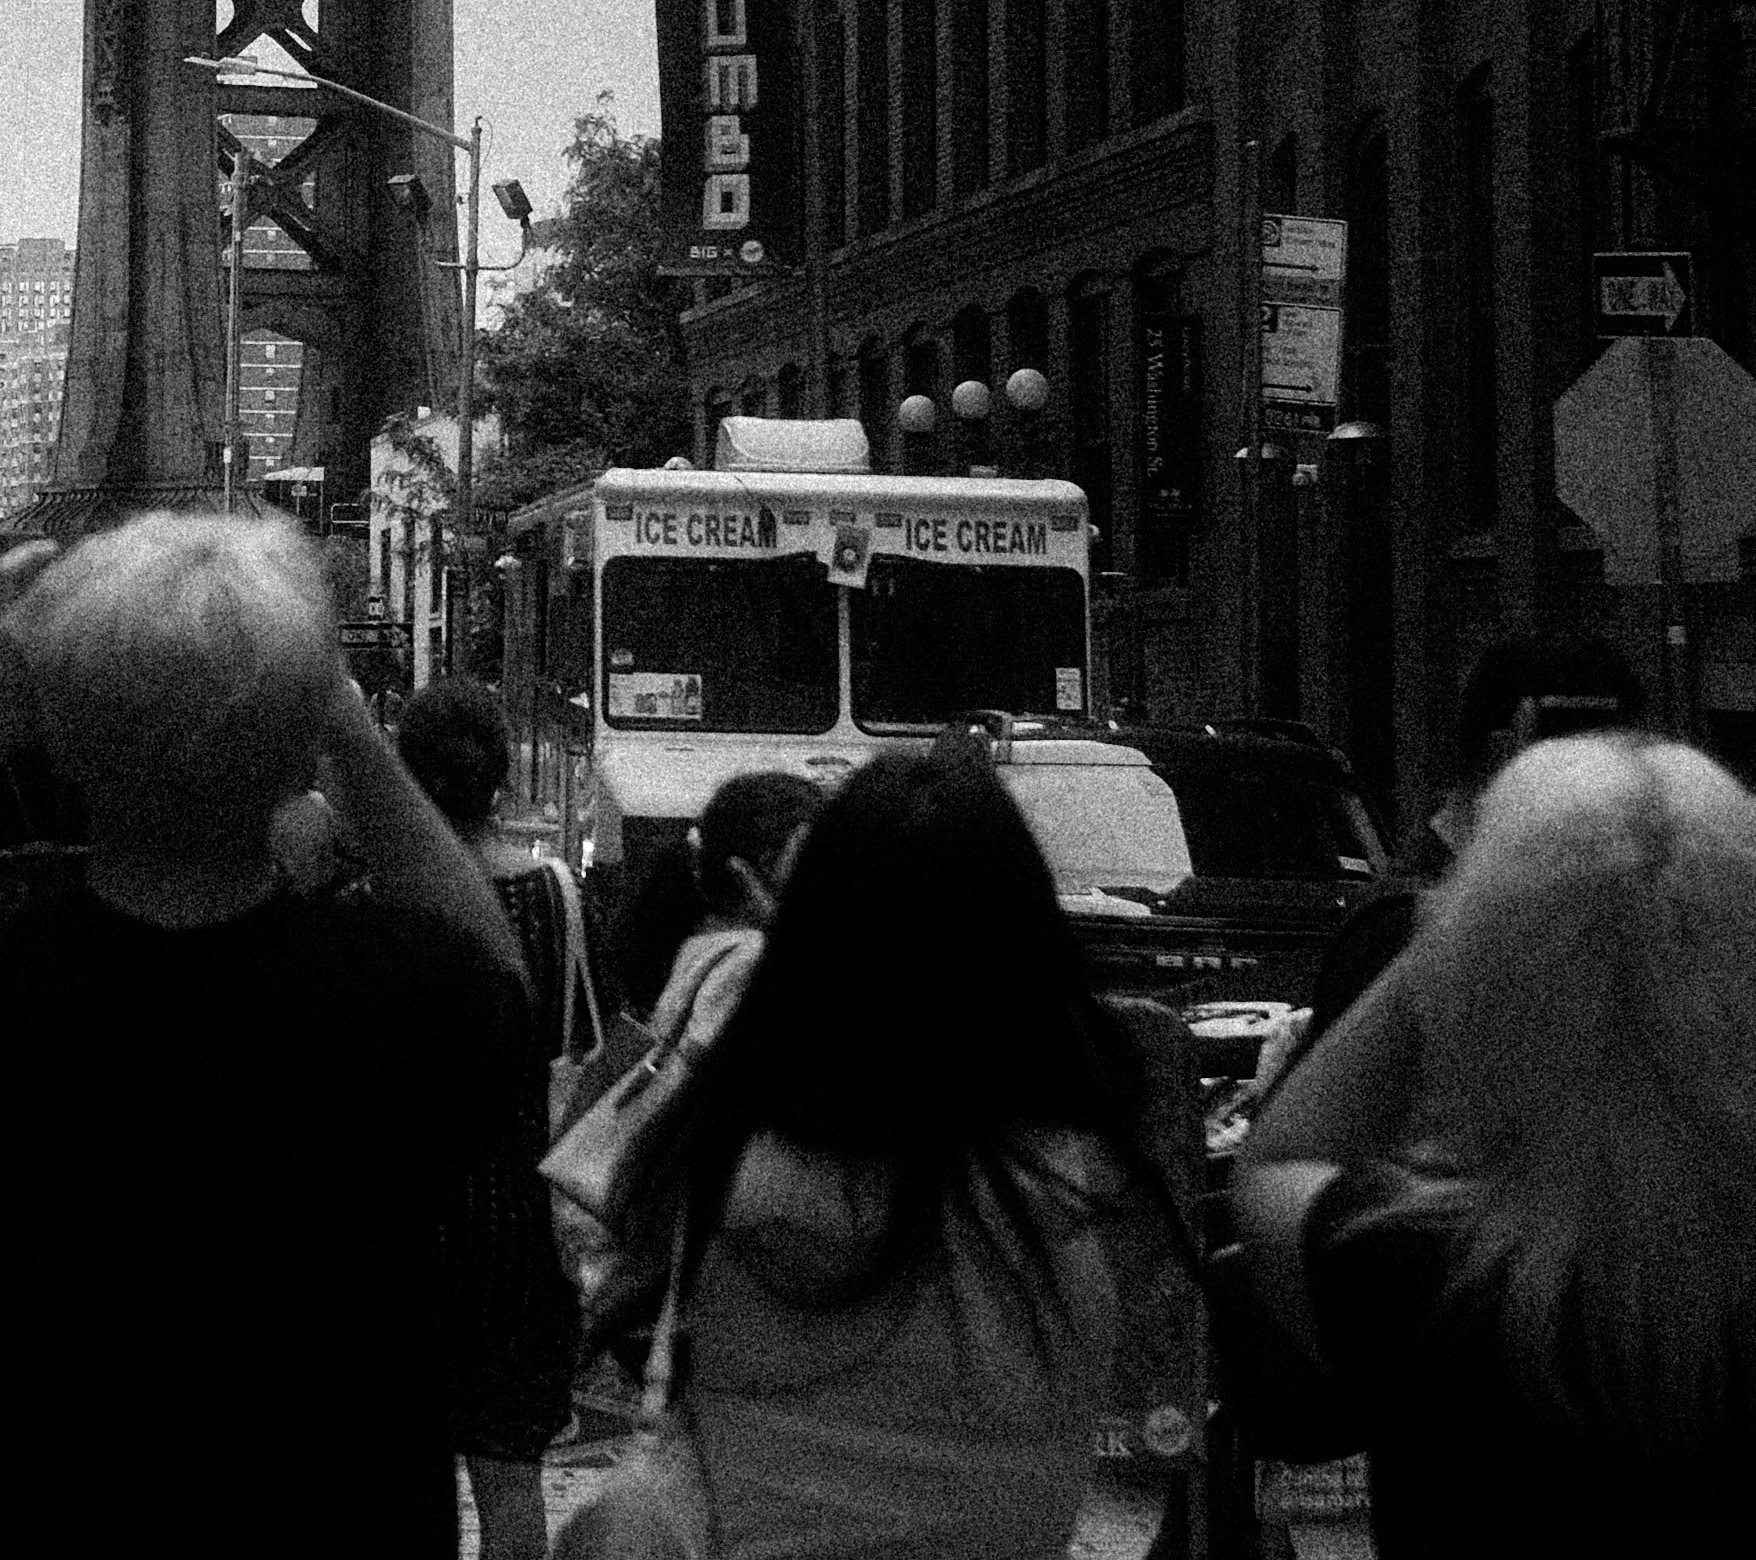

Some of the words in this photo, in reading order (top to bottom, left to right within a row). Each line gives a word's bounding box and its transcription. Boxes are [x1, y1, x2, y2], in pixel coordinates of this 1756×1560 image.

[1145, 326, 1164, 349] 25
[636, 512, 677, 546] ICE
[686, 514, 778, 549] CREAM
[904, 519, 947, 554] ICE
[956, 521, 1048, 556] CREAM
